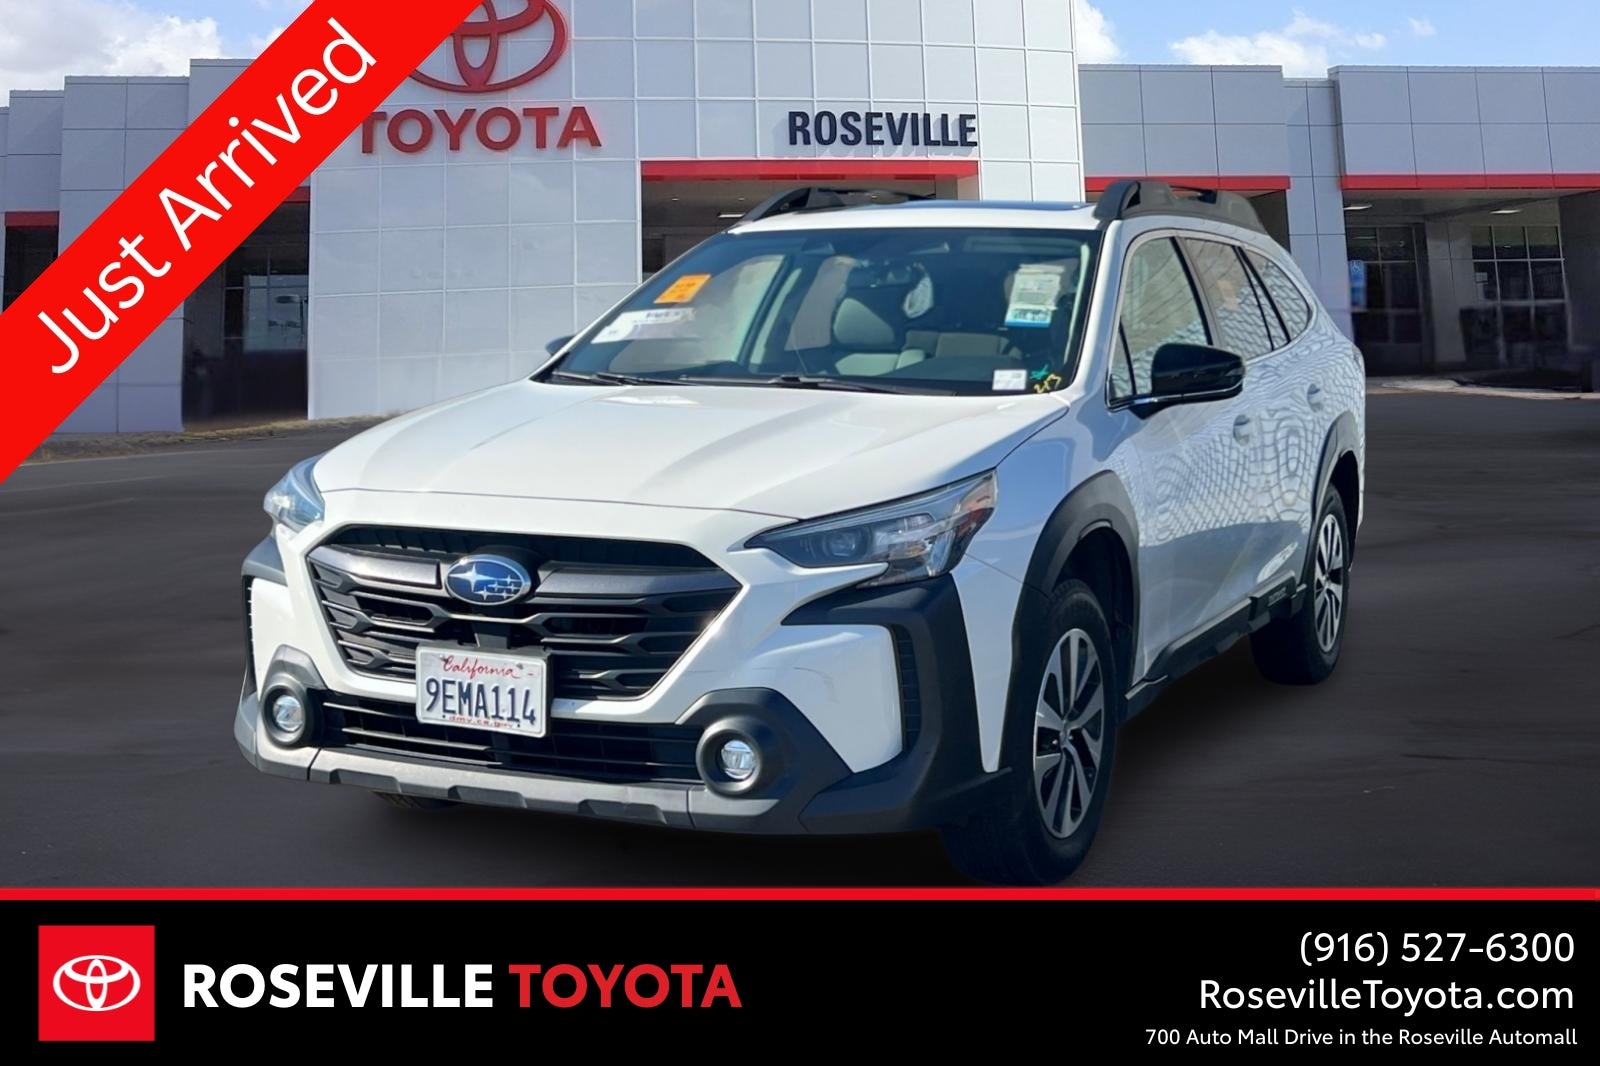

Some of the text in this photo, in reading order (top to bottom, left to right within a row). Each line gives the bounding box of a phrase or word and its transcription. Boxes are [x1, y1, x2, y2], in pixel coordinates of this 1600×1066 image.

[361, 106, 602, 154] TOYOTA
[788, 110, 978, 147] ROSEVILLE
[443, 655, 520, 679] California
[426, 678, 536, 725] 9EMA114
